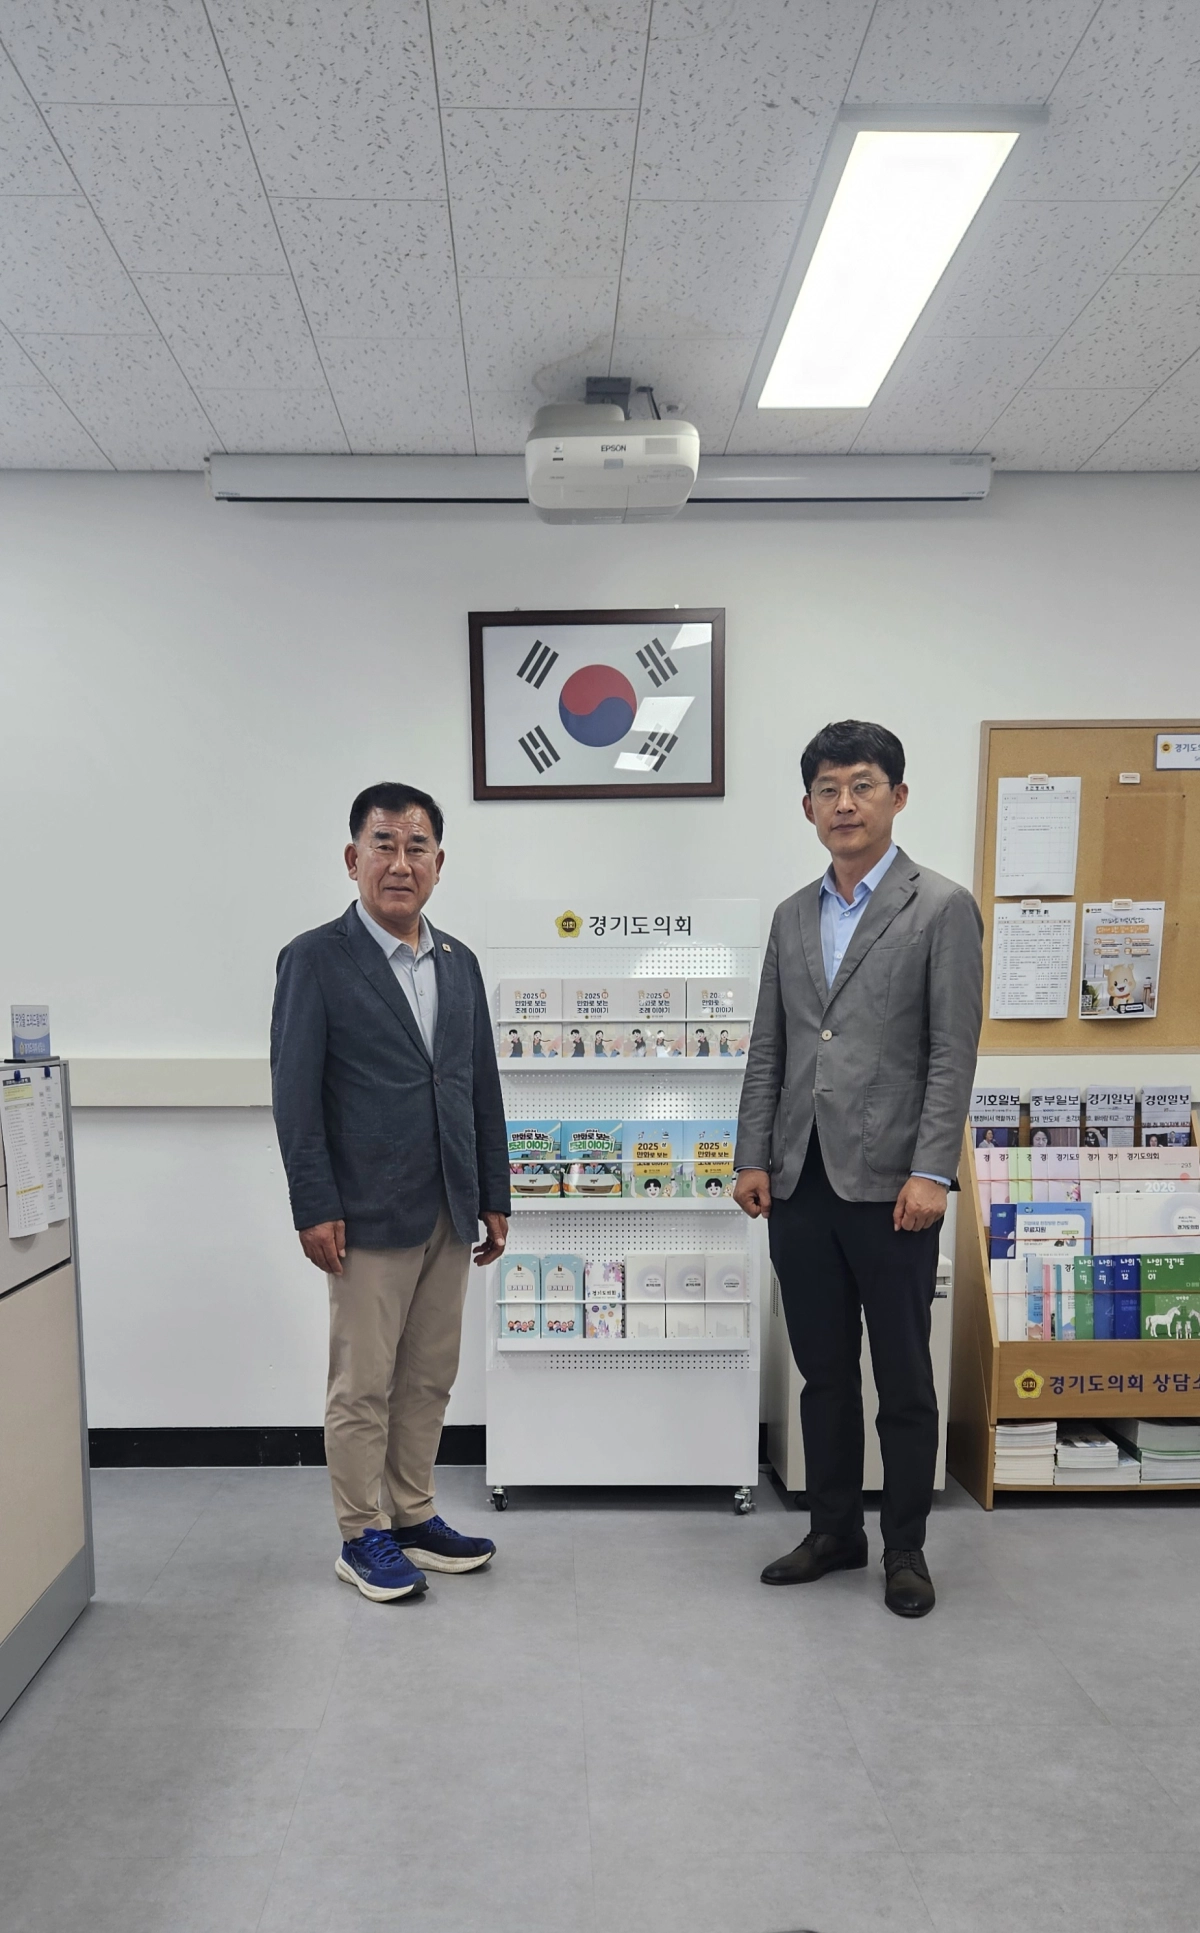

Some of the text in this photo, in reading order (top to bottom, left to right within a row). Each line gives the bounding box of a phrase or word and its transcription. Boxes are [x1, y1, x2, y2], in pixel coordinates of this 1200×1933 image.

[589, 915, 692, 936] 경기도의회
[976, 1094, 1020, 1106] 기호일보
[1032, 1095, 1079, 1106] 중부일보
[1088, 1094, 1134, 1105] 경기일보
[1145, 1095, 1189, 1106] 경인일보
[526, 1141, 552, 1151] 이야기
[588, 1141, 613, 1151] 이야기
[1144, 1182, 1176, 1192] 2026
[1120, 1258, 1134, 1266] 나의
[1147, 1258, 1185, 1269] 나의 경기도
[1049, 1374, 1144, 1395] 경기도의회
